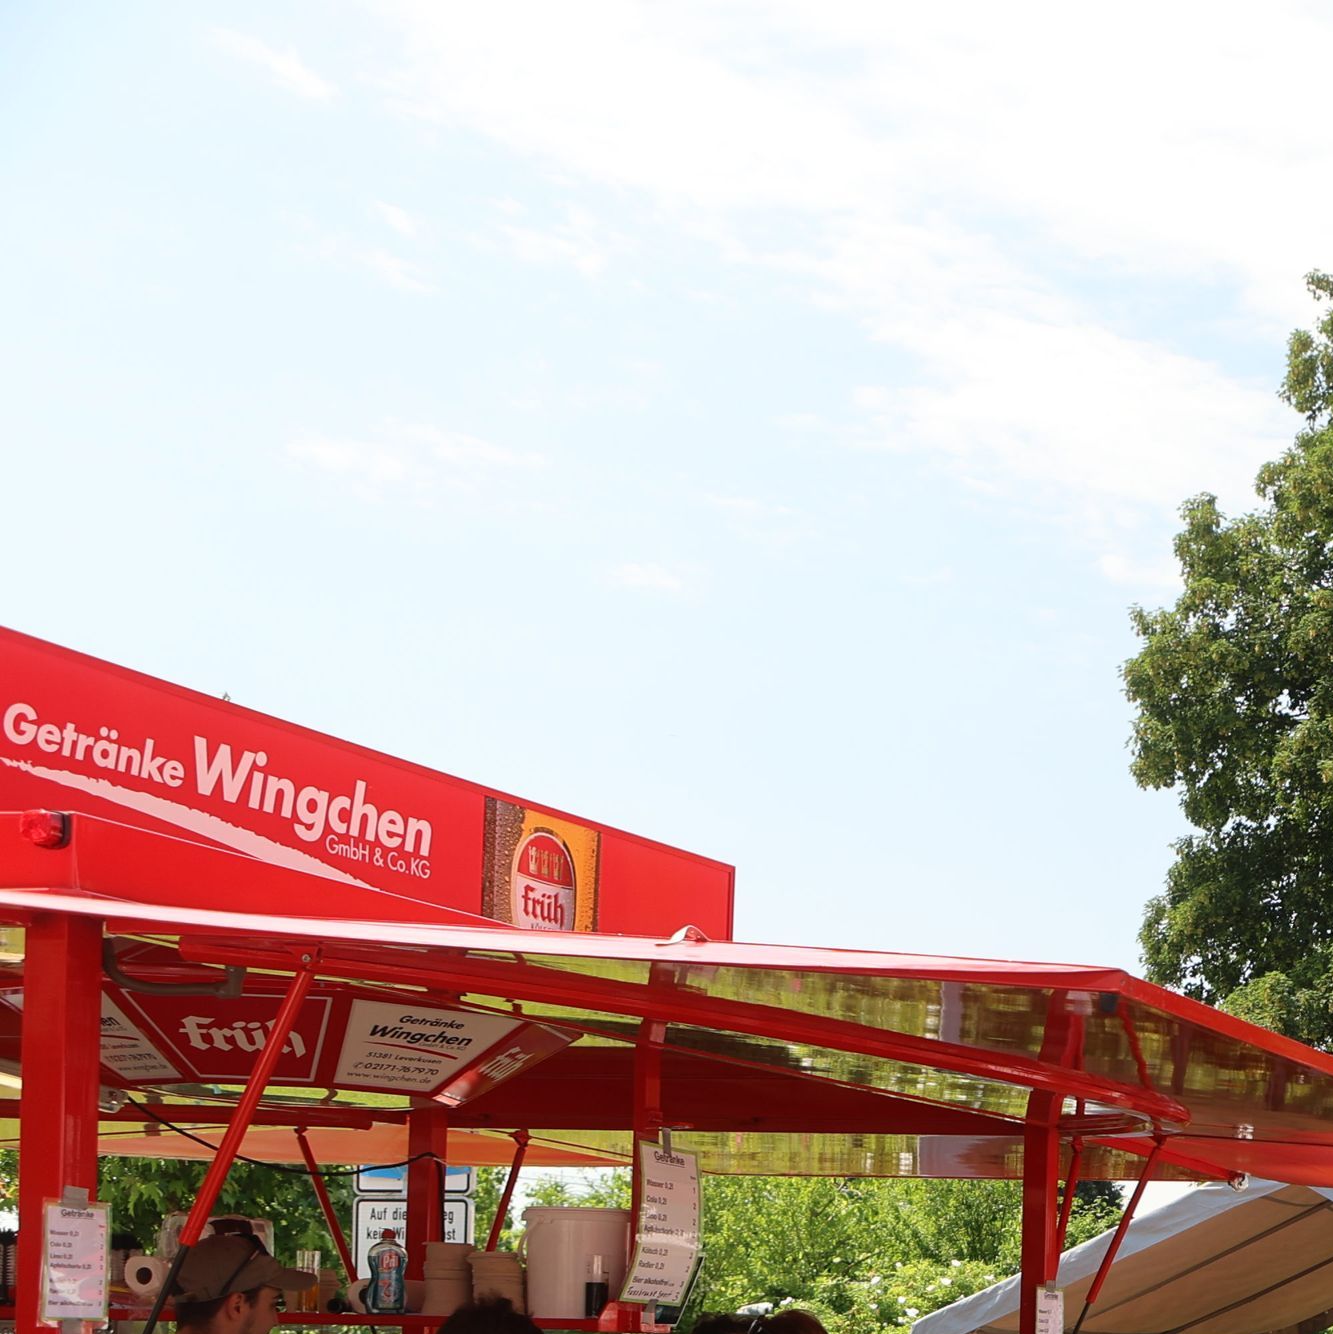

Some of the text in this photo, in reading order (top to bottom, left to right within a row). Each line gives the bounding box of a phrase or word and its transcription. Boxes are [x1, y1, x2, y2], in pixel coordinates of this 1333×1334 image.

[3, 703, 432, 856] Getränke Wingchen
[326, 834, 370, 863] GmbH
[374, 848, 385, 867] &
[521, 884, 565, 928] früh
[399, 1015, 465, 1030] Getränke
[369, 1024, 473, 1047] Wingchen
[395, 1053, 443, 1065] Leverkusen
[370, 1207, 388, 1221] Auf
[443, 1209, 454, 1225] eg
